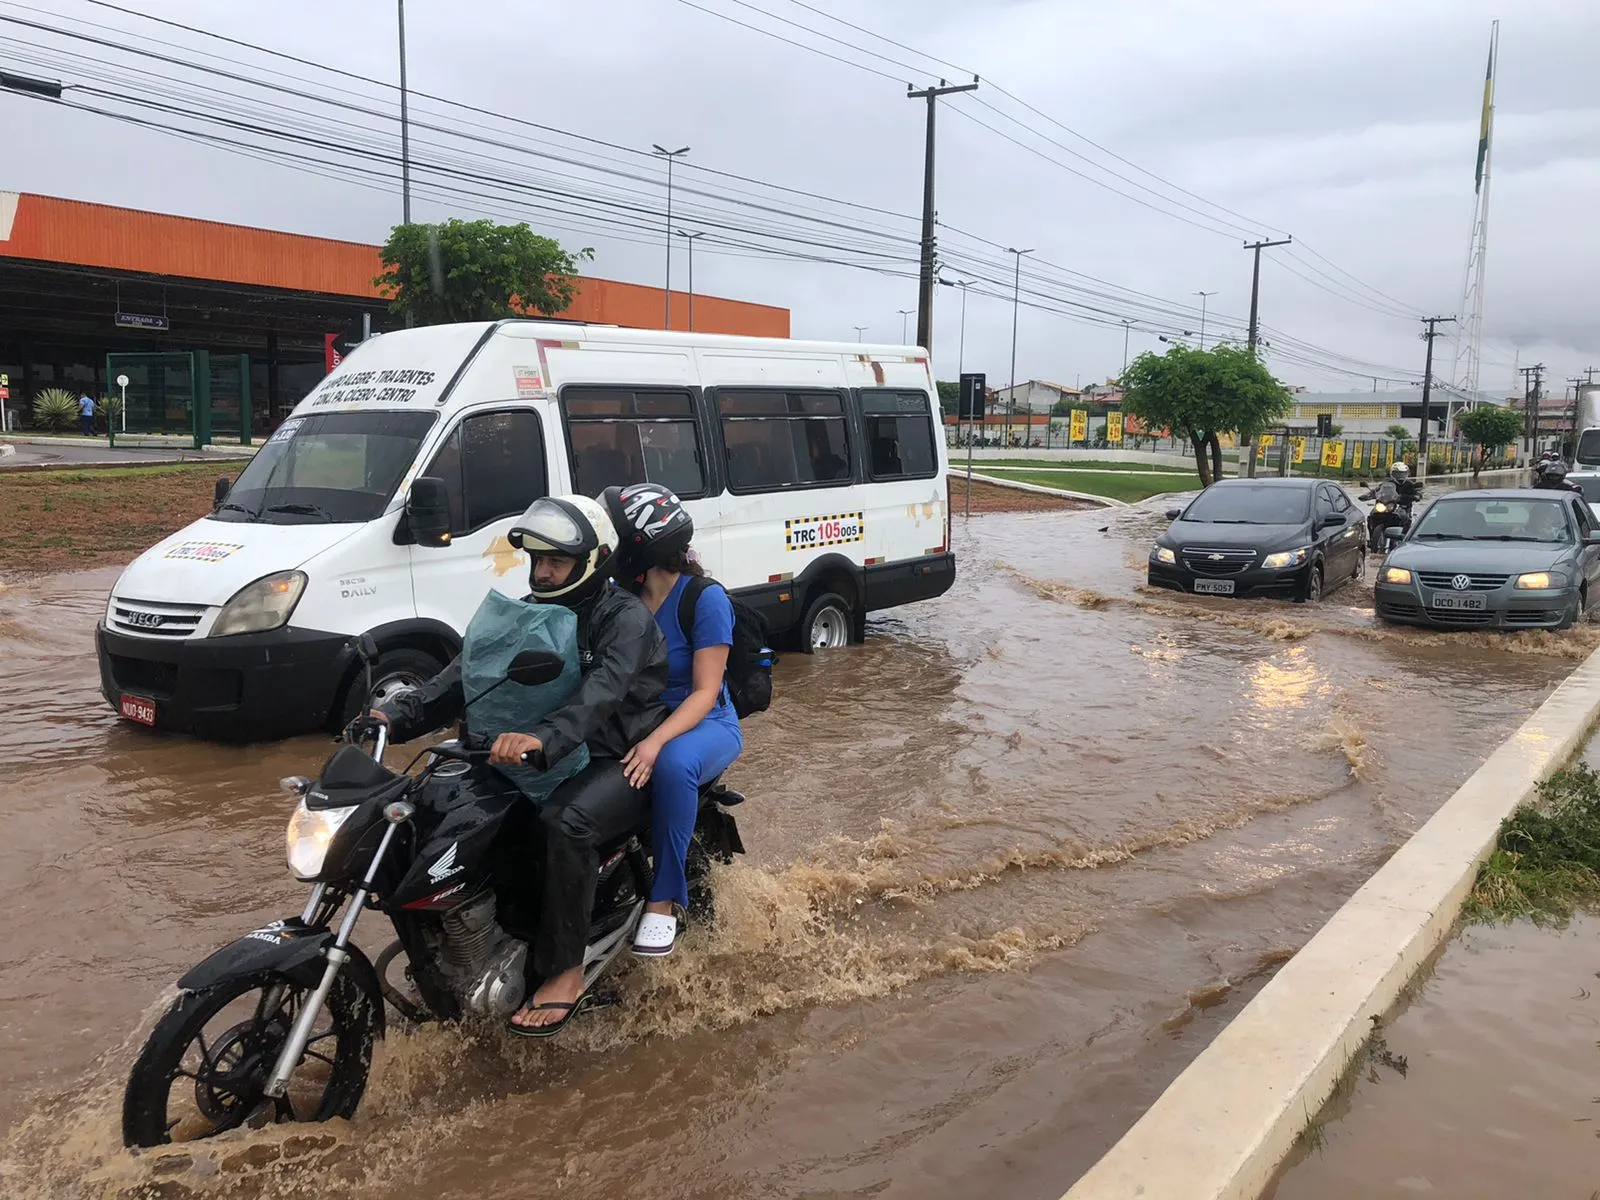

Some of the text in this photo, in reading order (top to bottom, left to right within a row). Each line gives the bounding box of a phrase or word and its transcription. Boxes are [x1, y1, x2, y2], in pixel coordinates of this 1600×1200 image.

[376, 387, 416, 402] CENTRO
[793, 528, 816, 543] TRC
[817, 521, 841, 540] 105
[341, 586, 377, 599] DAILY
[1457, 599, 1482, 609] 1482
[127, 610, 163, 628] IVECO
[430, 865, 466, 885] HONDA
